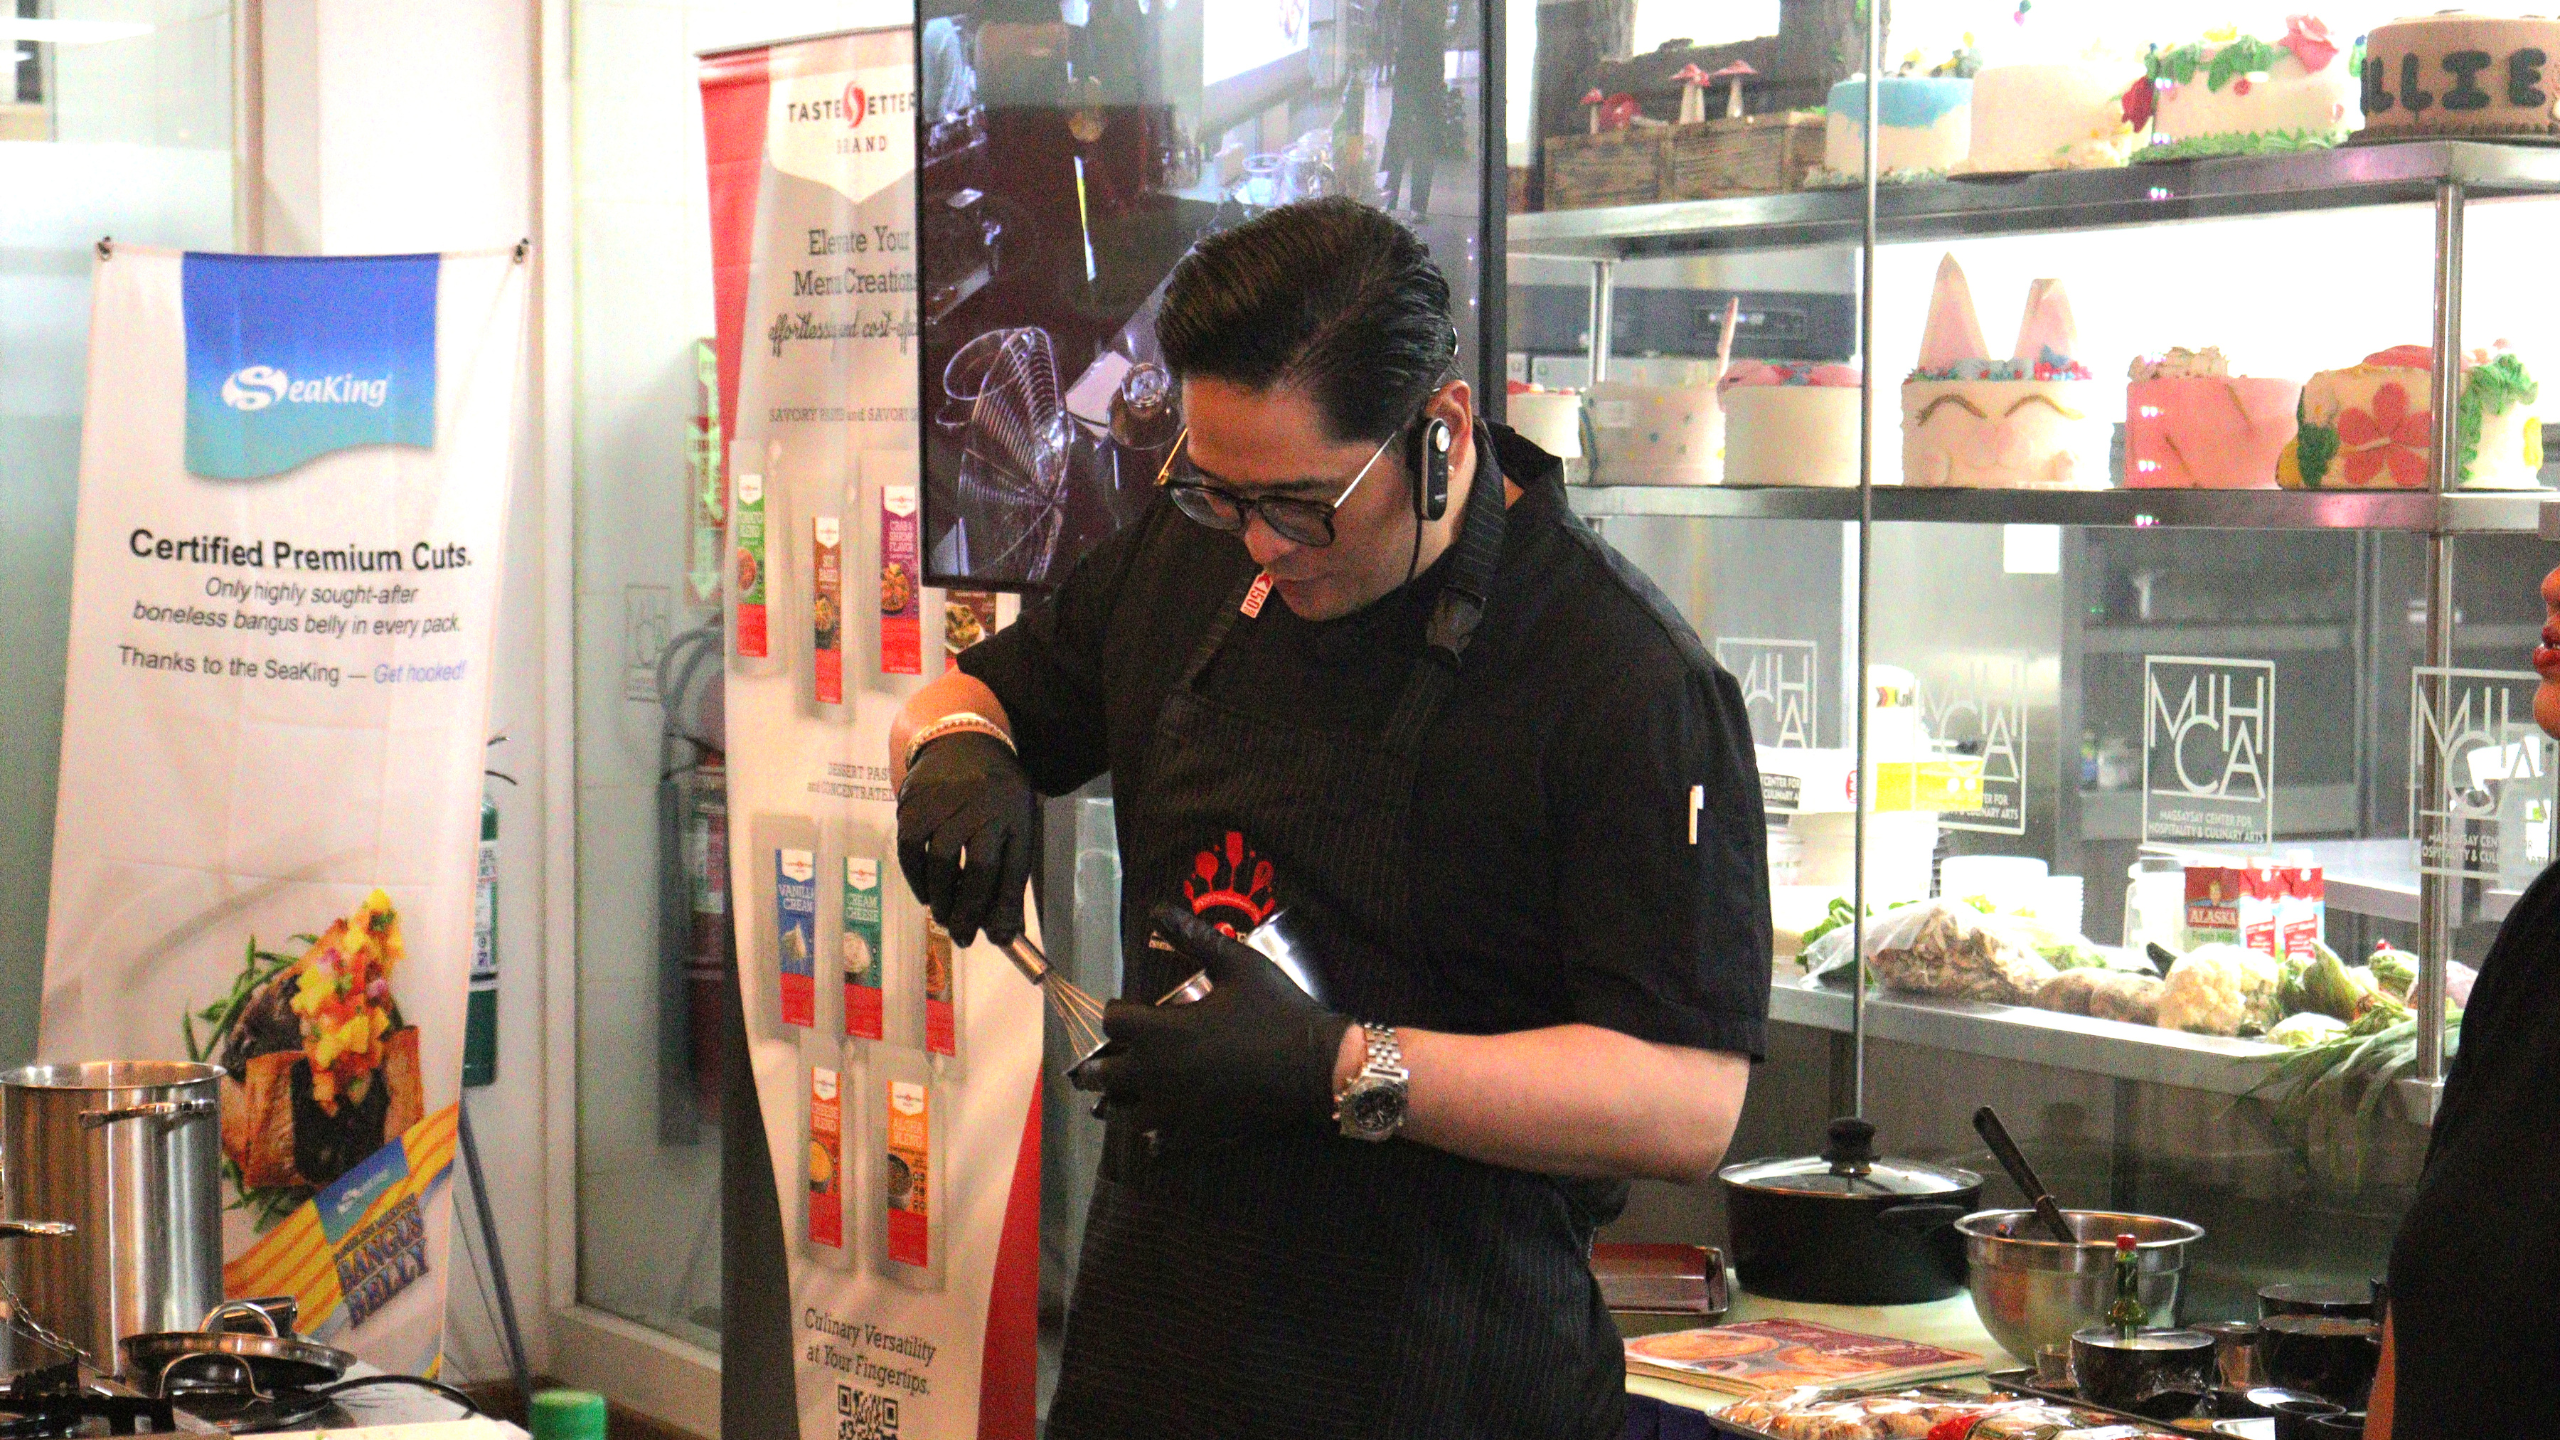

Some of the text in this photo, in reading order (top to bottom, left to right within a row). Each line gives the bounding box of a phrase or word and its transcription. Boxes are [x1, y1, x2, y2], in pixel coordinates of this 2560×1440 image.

[837, 136, 888, 154] BRAND
[808, 225, 910, 256] Elevate Your
[221, 366, 387, 411] SeaKing
[129, 529, 473, 571] Certified Premium Cuts.
[205, 577, 418, 608] Only highly sought-after
[133, 601, 461, 638] boneless bangus belly in every pack.
[118, 645, 195, 673] Thanks
[202, 654, 221, 675] to
[229, 656, 257, 678] the
[264, 656, 340, 687] SeaKing
[373, 662, 402, 684] Get
[406, 660, 467, 683] hooked!
[2190, 908, 2237, 926] ALASKA
[804, 1308, 937, 1367] Culinary Versatility
[807, 1344, 931, 1396] at Your Fingertips.
